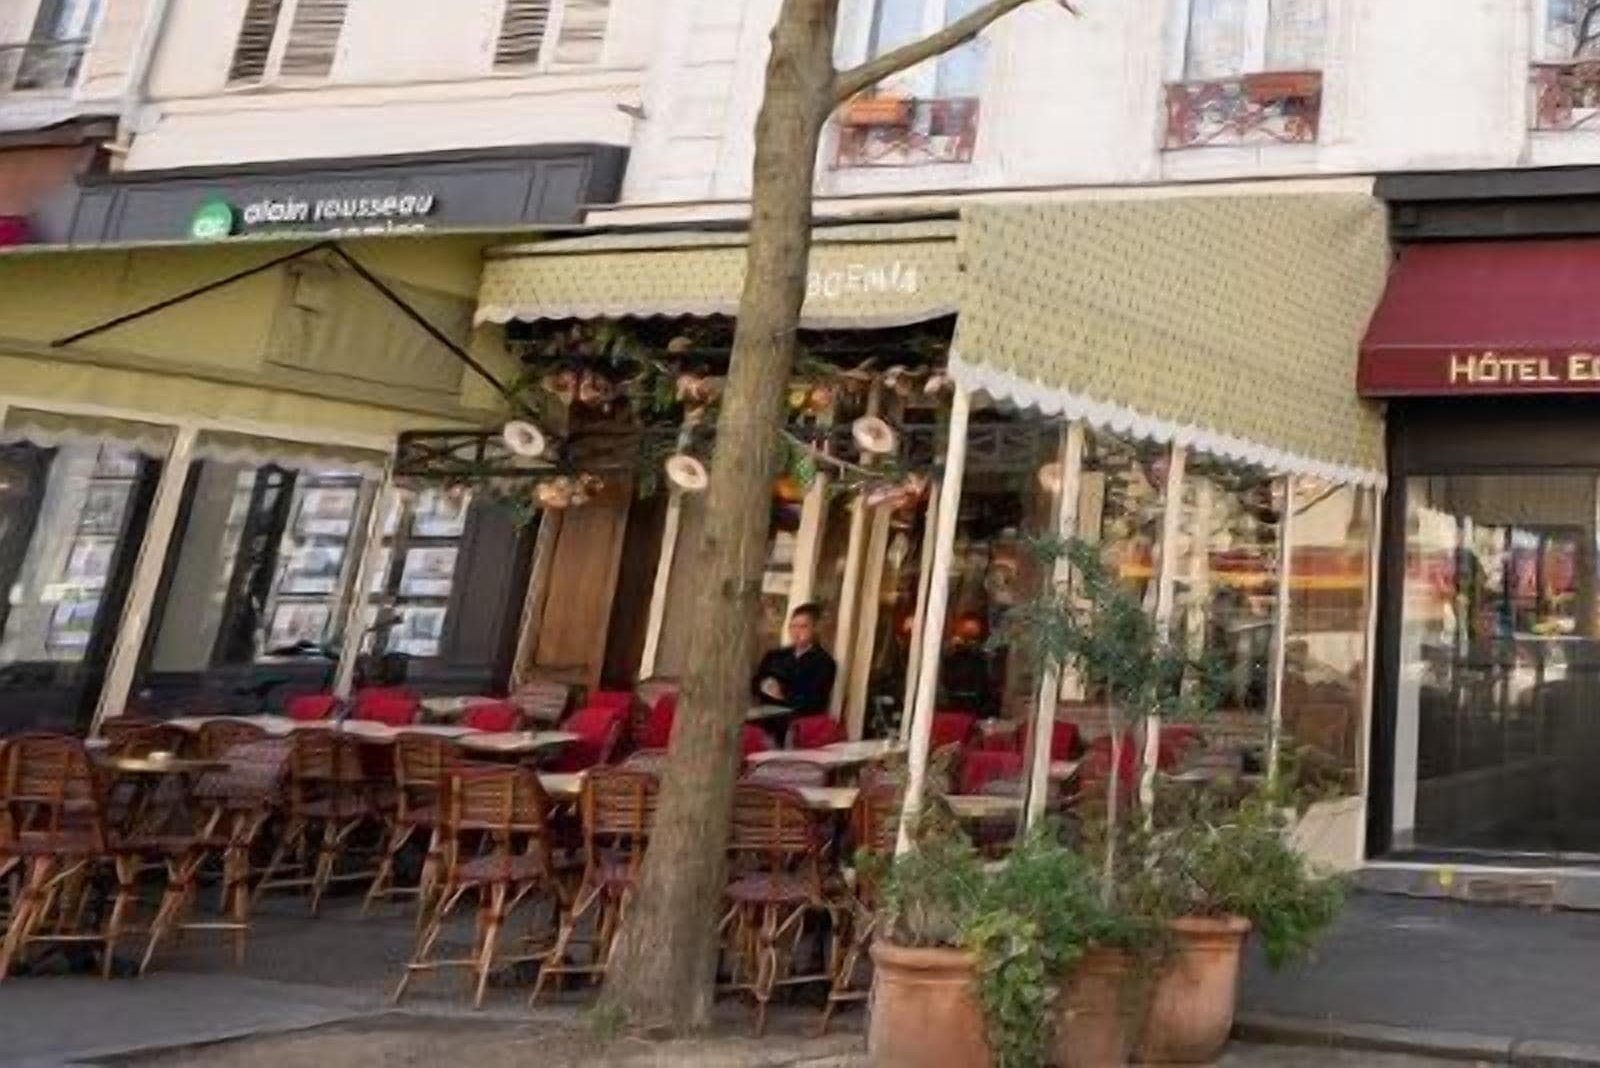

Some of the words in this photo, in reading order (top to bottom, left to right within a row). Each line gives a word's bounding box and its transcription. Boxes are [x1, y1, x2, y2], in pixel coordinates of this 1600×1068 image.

[244, 194, 308, 223] alain
[313, 192, 433, 220] rousseau
[1449, 350, 1560, 384] HÔTEL
